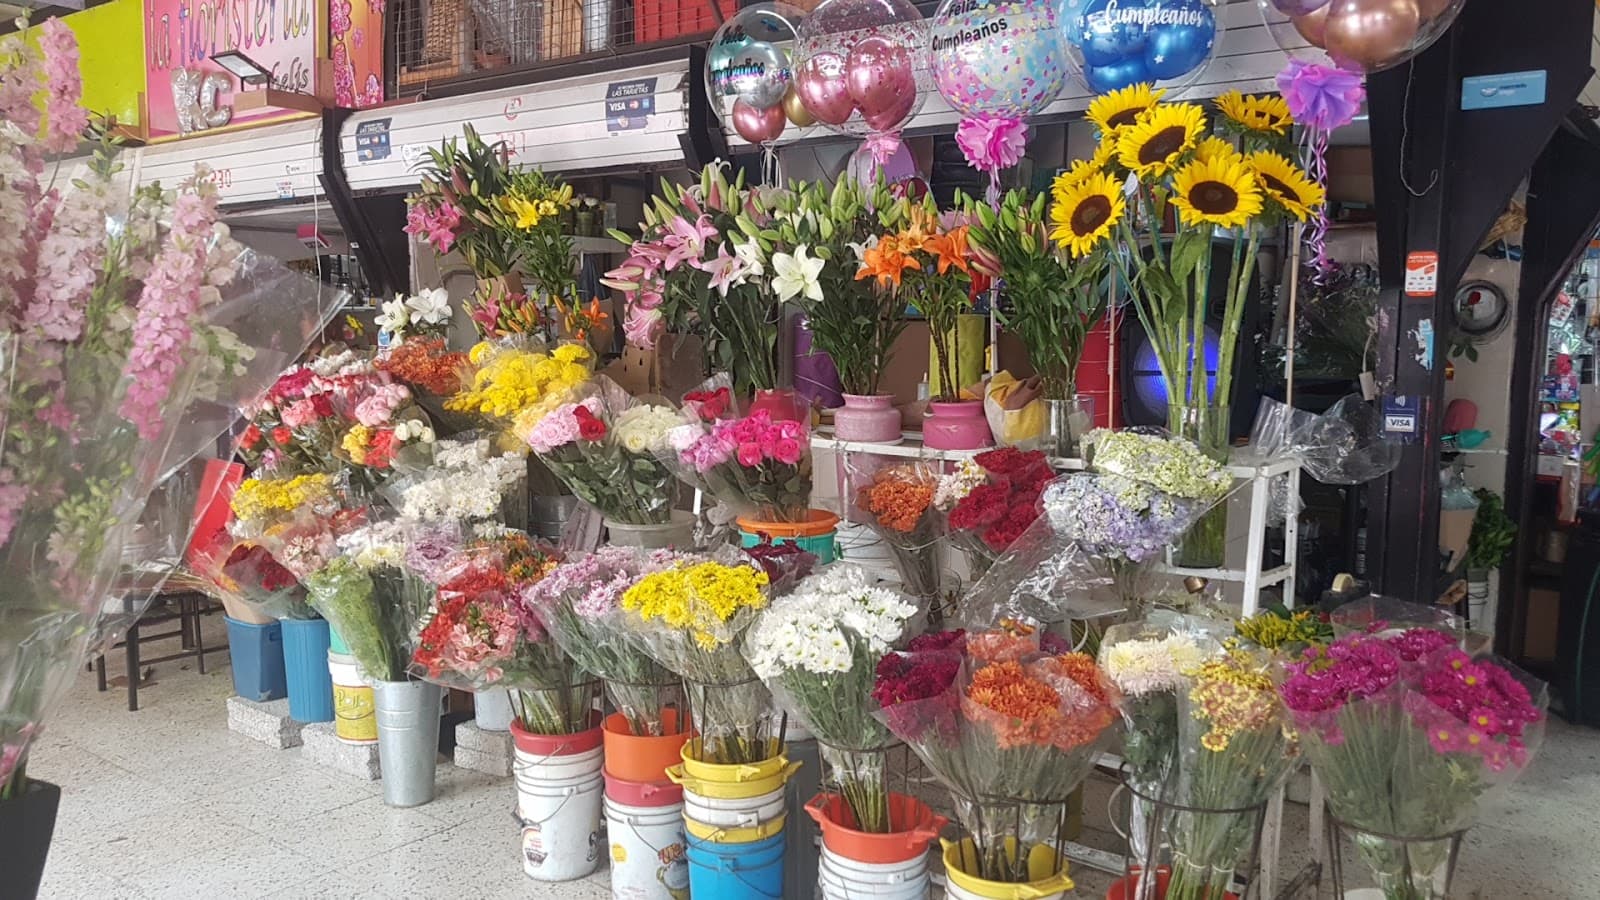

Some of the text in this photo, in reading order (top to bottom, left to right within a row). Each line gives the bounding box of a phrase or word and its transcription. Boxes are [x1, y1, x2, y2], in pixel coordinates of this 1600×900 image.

[947, 0, 978, 18] Feliz
[1105, 0, 1203, 33] Cumpleaños
[932, 17, 1008, 52] Cumpleaños
[609, 101, 626, 112] VISA
[1390, 418, 1411, 427] VISA
